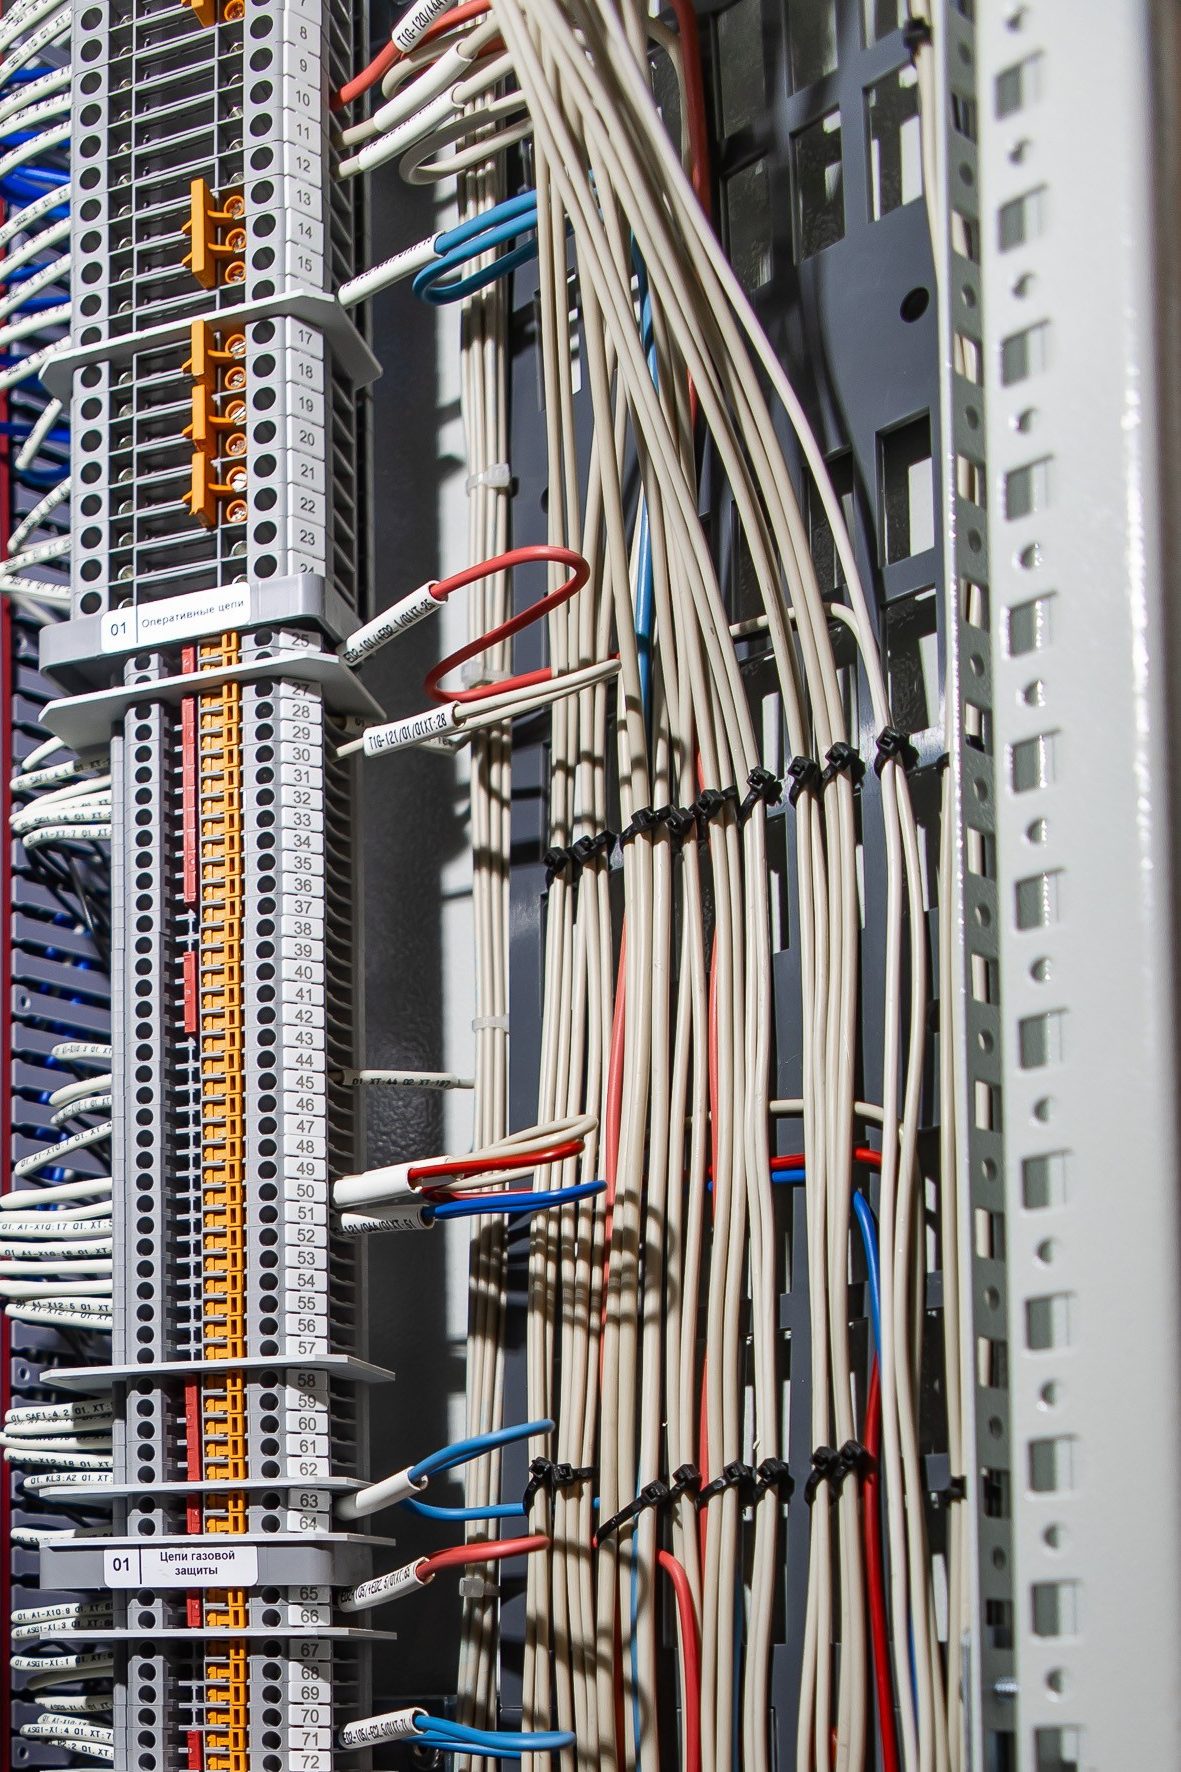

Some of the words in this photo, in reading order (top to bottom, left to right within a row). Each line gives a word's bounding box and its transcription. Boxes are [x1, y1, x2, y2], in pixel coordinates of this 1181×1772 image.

[300, 26, 307, 40] 8
[299, 58, 307, 72] 9
[296, 90, 310, 106] 10
[297, 124, 309, 140] 11
[296, 156, 311, 173] 12
[297, 189, 311, 206] 13
[298, 222, 312, 239] 14
[298, 256, 313, 272] 15
[298, 329, 313, 344] 17
[299, 362, 313, 379] 18
[299, 396, 313, 412] 19
[299, 430, 315, 446] 20
[301, 463, 314, 480] 21
[300, 497, 315, 514] 22
[300, 529, 315, 546] 23
[111, 622, 127, 636] 01
[141, 605, 215, 628] Оперативные
[218, 599, 244, 616] цепи
[291, 632, 309, 648] 25
[292, 682, 310, 697] 27
[292, 704, 310, 718] 28
[293, 726, 310, 740] 29
[293, 747, 311, 762] 30
[294, 768, 309, 783] 31
[293, 790, 311, 805] 32
[293, 812, 311, 827] 33
[293, 834, 311, 848] 34
[294, 856, 312, 870] 35
[295, 878, 312, 892] 36
[295, 900, 313, 914] 37
[294, 921, 312, 936] 38
[294, 943, 312, 958] 39
[295, 965, 313, 980] 40
[295, 987, 311, 1002] 41
[295, 1009, 313, 1024] 42
[295, 1031, 313, 1046] 43
[295, 1053, 314, 1067] 44
[296, 1075, 314, 1090] 45
[296, 1097, 314, 1112] 46
[296, 1120, 315, 1134] 47
[296, 1139, 315, 1154] 48
[296, 1162, 315, 1176] 49
[297, 1184, 315, 1198] 50
[298, 1206, 313, 1220] 51
[297, 1228, 315, 1243] 52
[297, 1251, 315, 1266] 53
[297, 1273, 315, 1288] 54
[297, 1296, 315, 1310] 55
[298, 1318, 316, 1332] 56
[298, 1341, 316, 1354] 57
[299, 1417, 317, 1431] 60
[299, 1462, 318, 1476] 62
[299, 1516, 317, 1530] 64
[113, 1558, 130, 1572] 01
[160, 1551, 188, 1564] Цепи
[191, 1550, 235, 1561] газовой
[175, 1566, 218, 1576] защиты
[301, 1609, 319, 1624] 66
[301, 1667, 319, 1680] 68
[301, 1686, 319, 1700] 69
[301, 1709, 319, 1723] 70
[301, 1755, 319, 1769] 72
